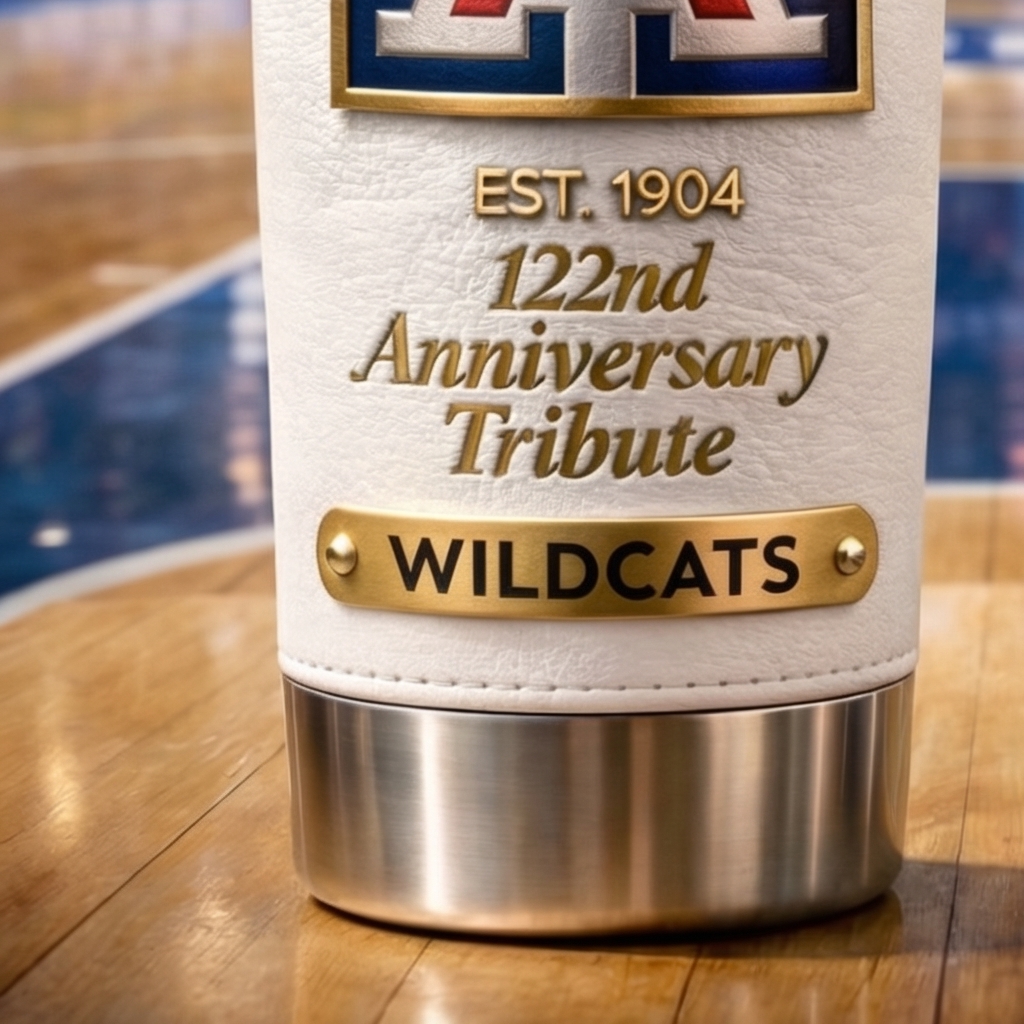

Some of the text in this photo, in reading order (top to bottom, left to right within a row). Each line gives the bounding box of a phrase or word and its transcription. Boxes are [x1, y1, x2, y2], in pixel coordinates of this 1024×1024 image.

[474, 166, 746, 219] EST. 1904
[488, 240, 715, 312] 122nd
[350, 311, 829, 408] Anniversary
[445, 402, 736, 478] Tribute
[387, 534, 800, 601] WILDCATS
